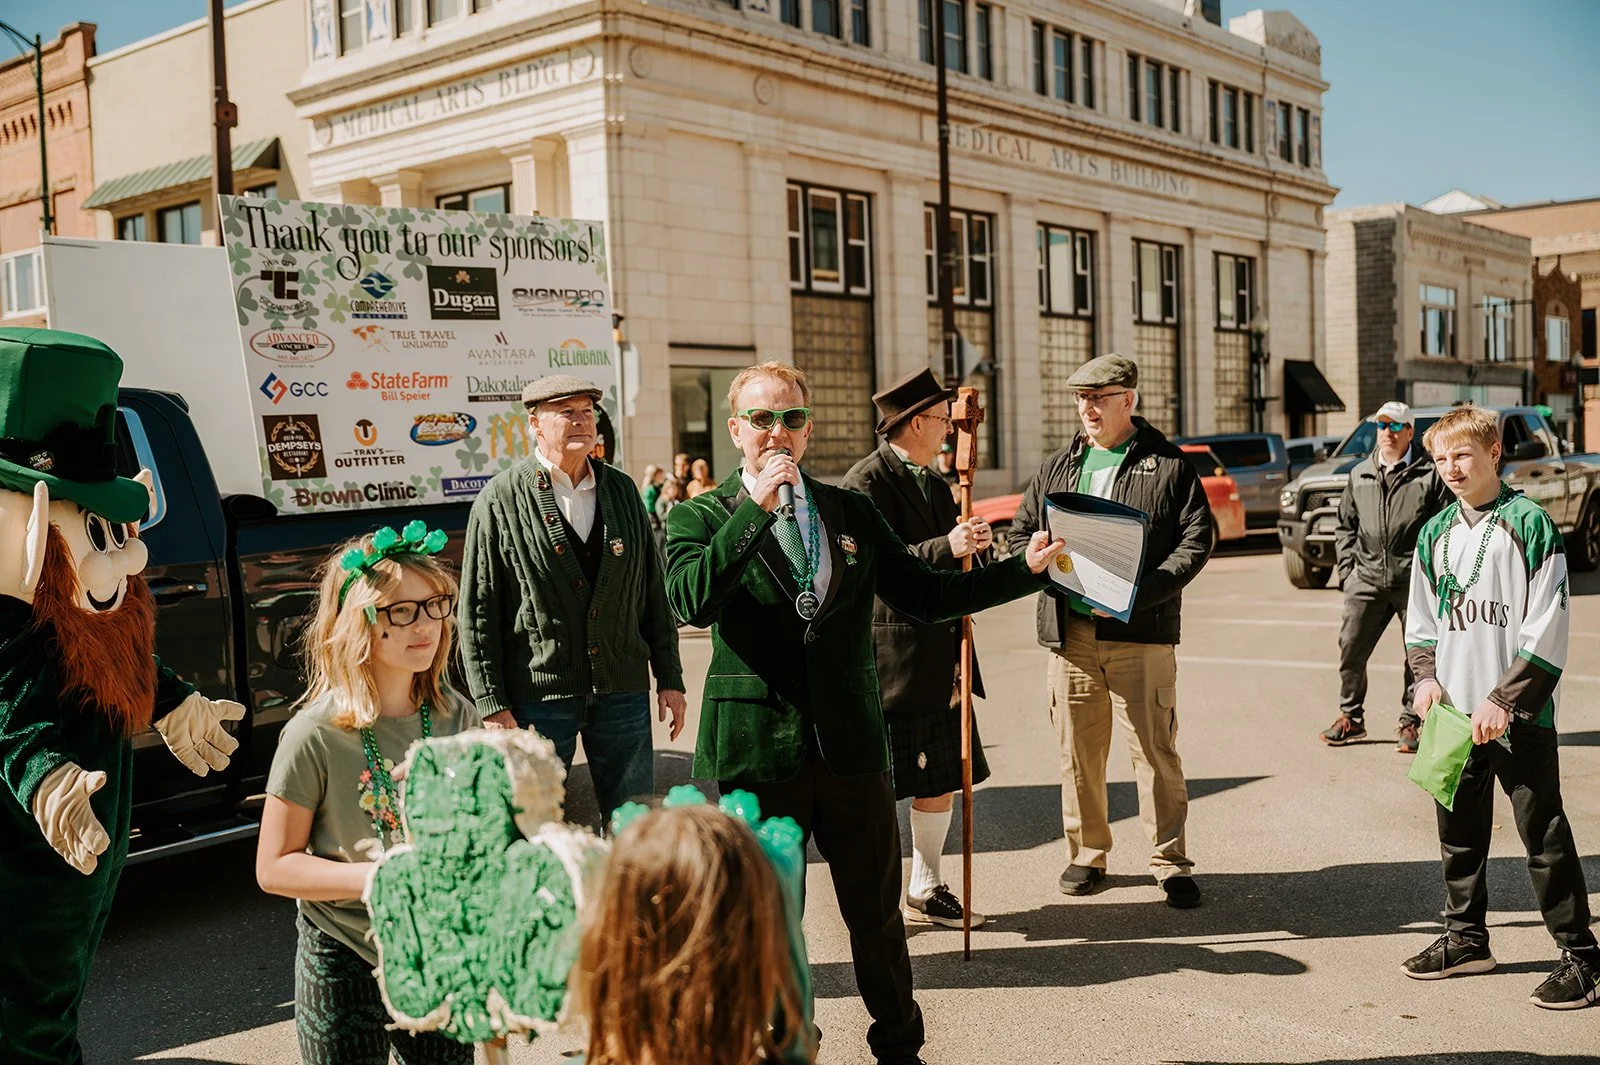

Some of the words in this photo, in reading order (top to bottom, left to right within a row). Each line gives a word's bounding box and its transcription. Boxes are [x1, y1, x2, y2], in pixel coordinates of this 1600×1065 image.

[341, 95, 424, 139] MEDICAL
[432, 77, 486, 116] ARTS
[949, 123, 1036, 164] EDICAL
[1047, 147, 1099, 177] ARTS
[1110, 160, 1191, 197] BUILDING
[238, 204, 332, 252] Thank
[336, 226, 391, 281] you
[401, 224, 427, 256] to
[438, 231, 480, 258] our
[489, 225, 596, 277] sponsors!
[432, 288, 497, 313] Dugan
[265, 332, 319, 346] ADVANCED
[389, 330, 416, 340] TRUE
[419, 330, 457, 340] TRAVEL
[402, 340, 449, 349] UNLIMITED
[467, 349, 537, 360] AVANTARA
[289, 381, 329, 398] GCC
[381, 391, 398, 401] Bill
[400, 390, 431, 403] Speier
[353, 448, 385, 456] TRAV'S
[334, 456, 406, 468] OUTFITTER
